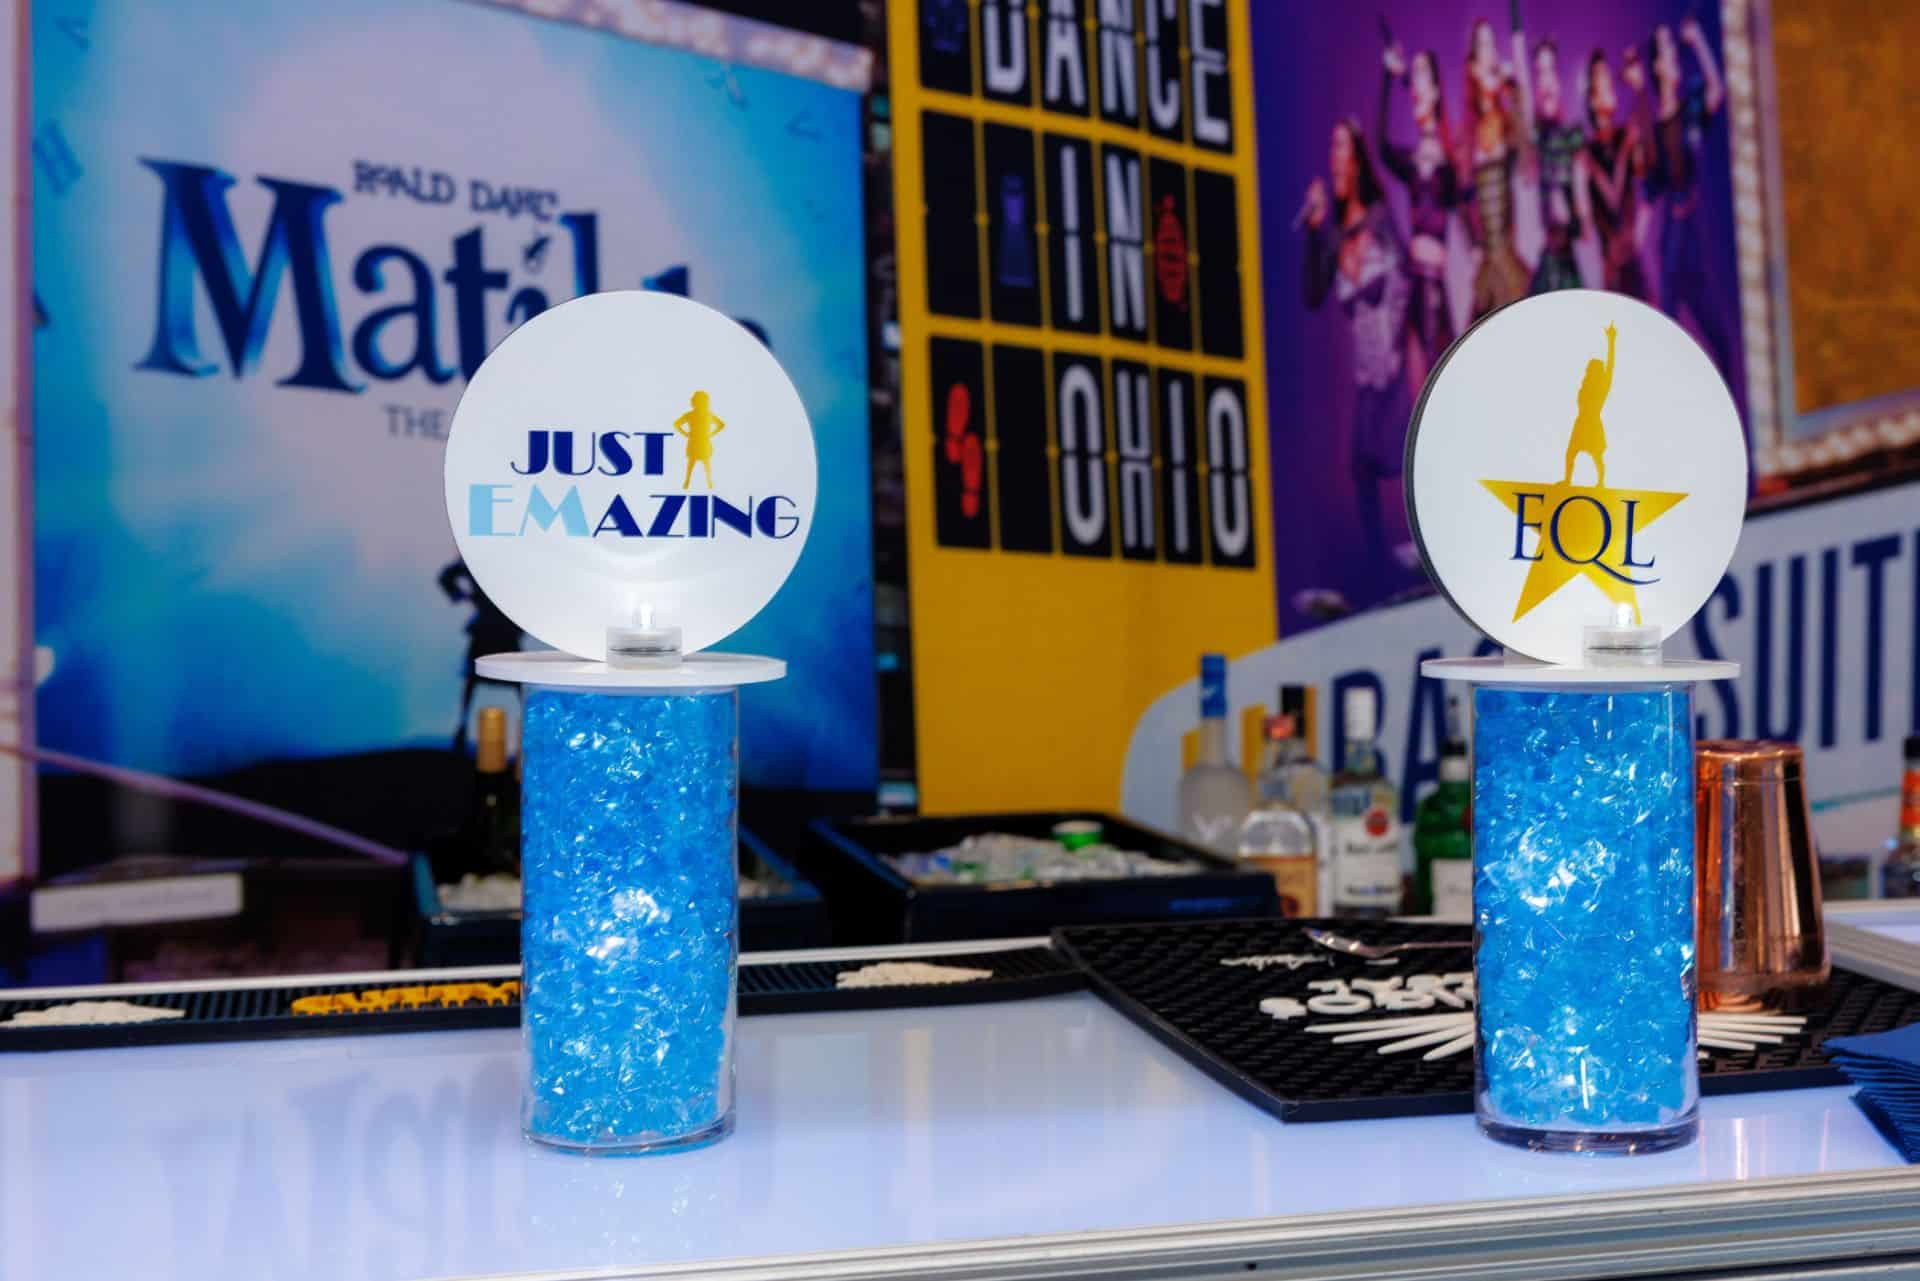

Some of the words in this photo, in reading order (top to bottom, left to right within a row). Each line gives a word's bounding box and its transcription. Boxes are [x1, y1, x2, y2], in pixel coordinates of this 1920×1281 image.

[1060, 145, 1147, 331] IN
[468, 483, 800, 539] EMAZING
[511, 430, 675, 476] JUST
[1060, 364, 1251, 558] OHIO
[1509, 492, 1661, 585] EQL
[1692, 527, 1920, 749] SUIT
